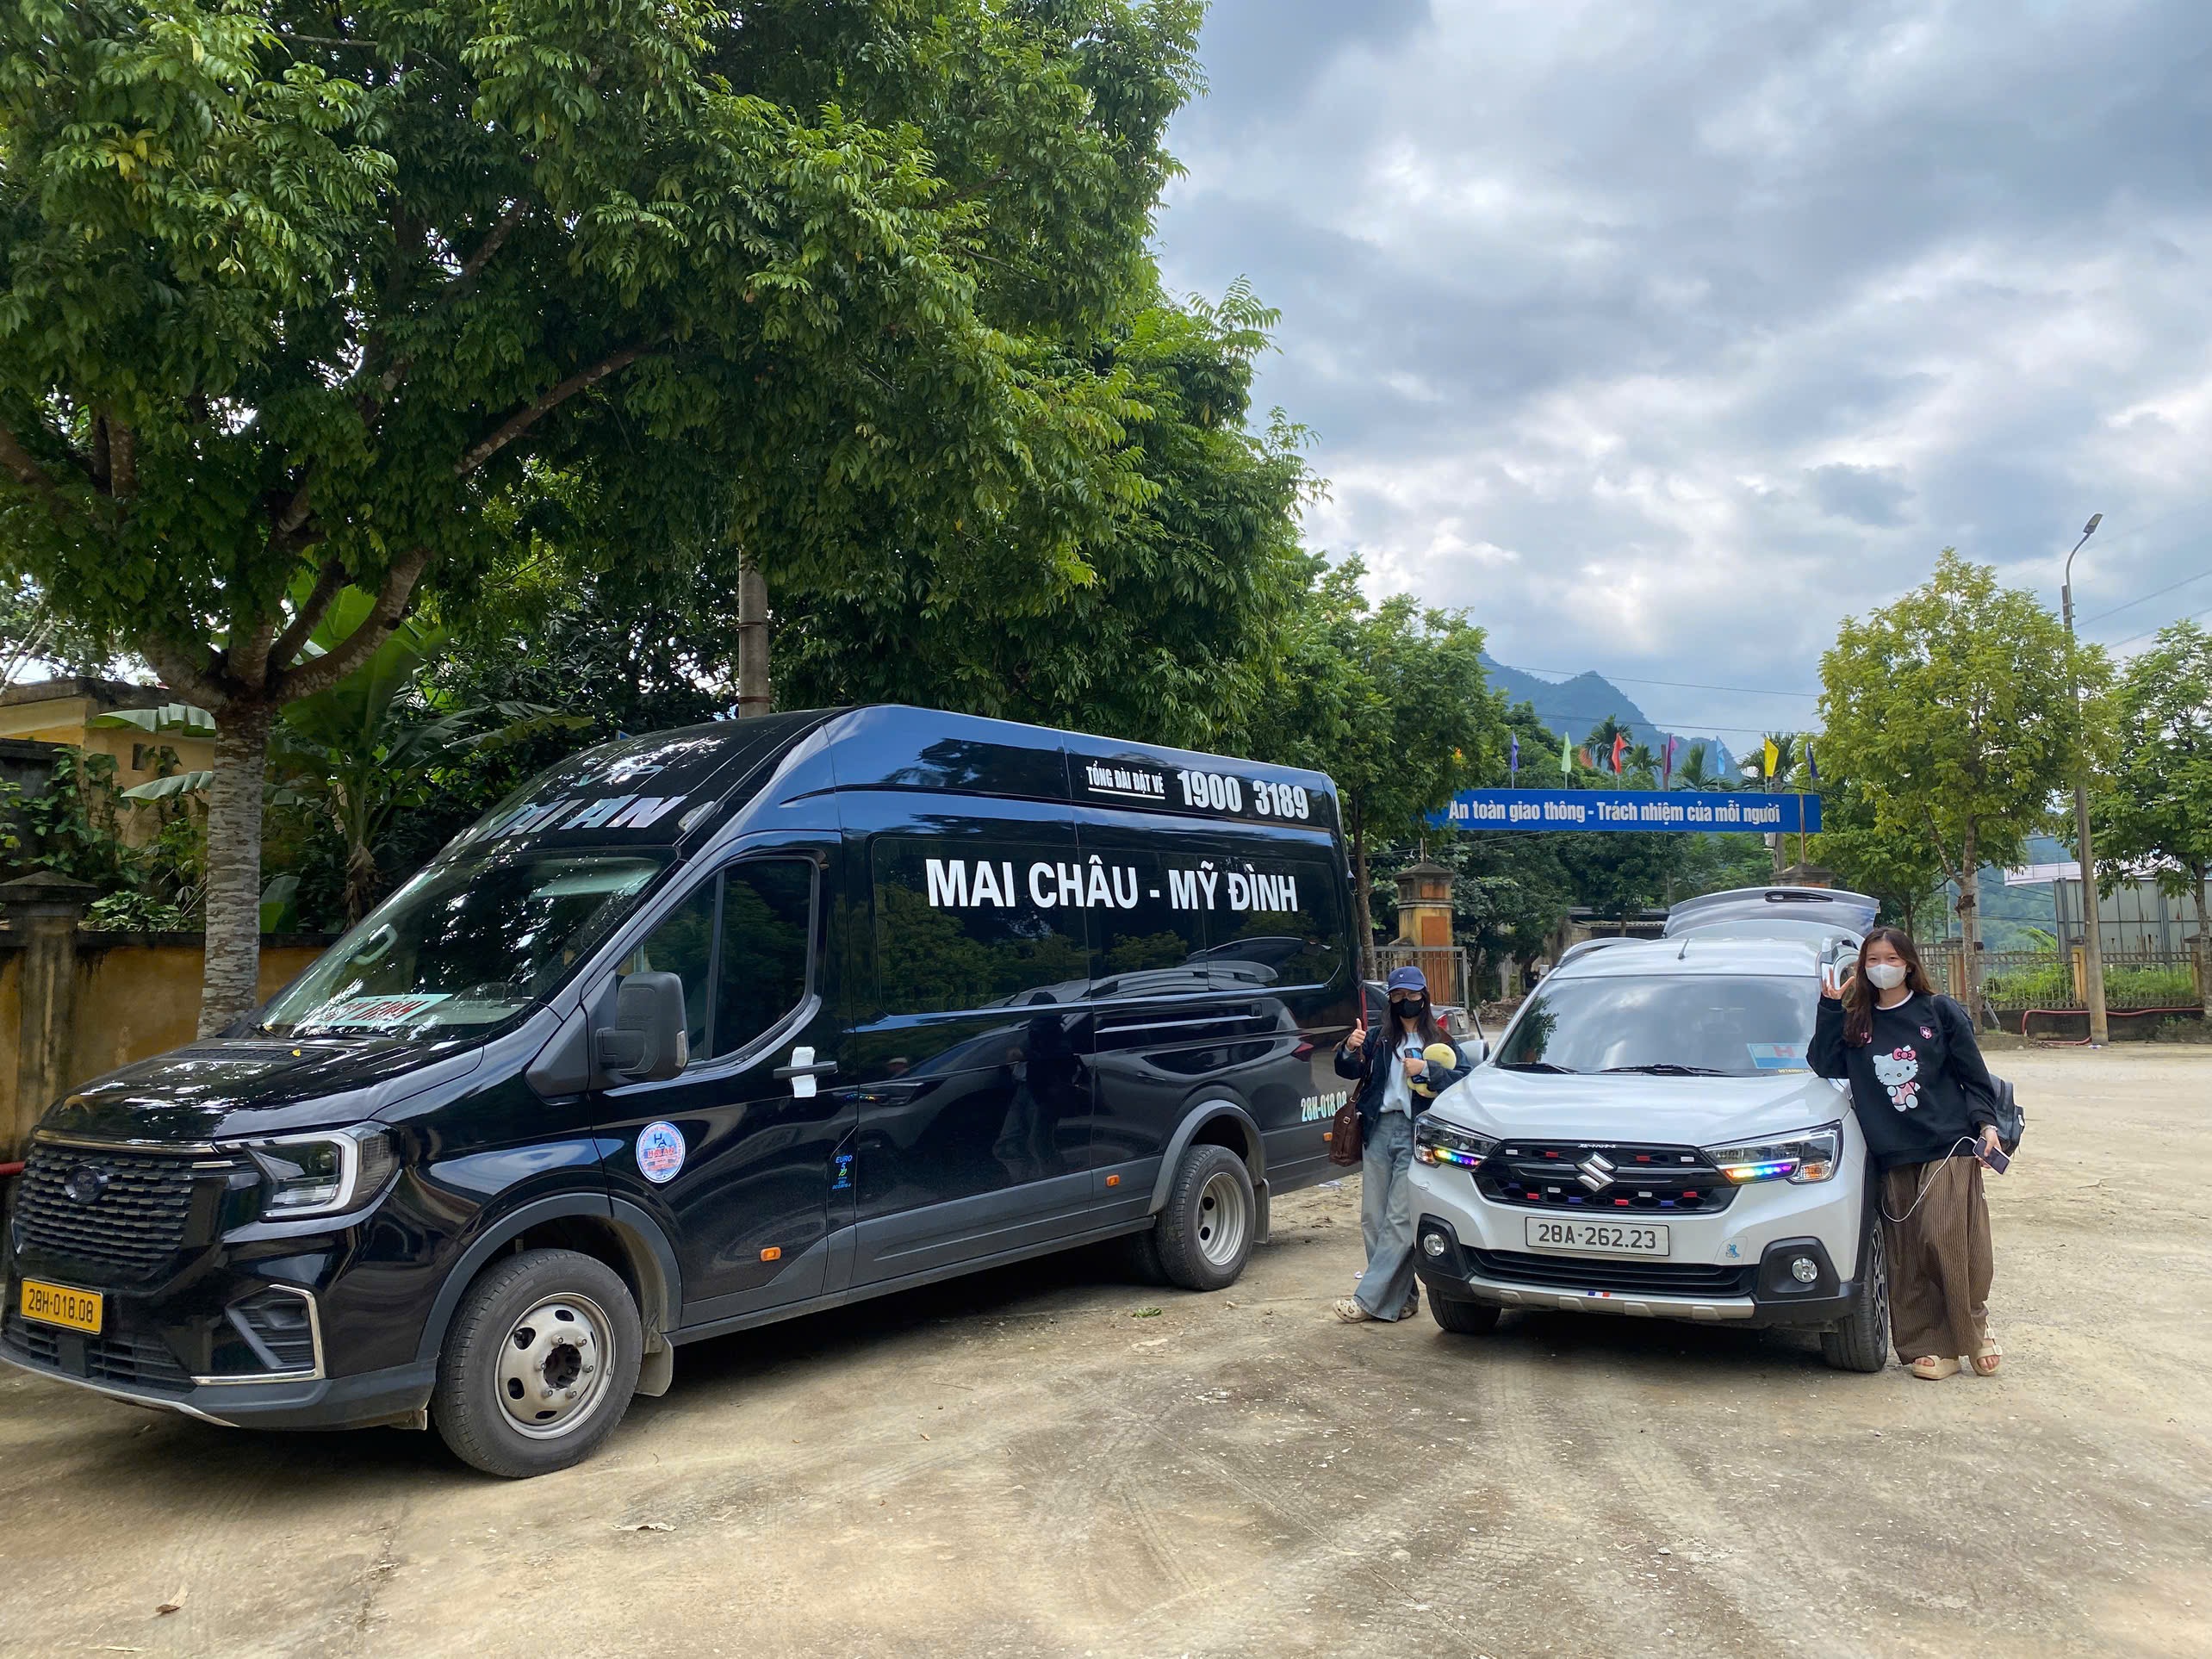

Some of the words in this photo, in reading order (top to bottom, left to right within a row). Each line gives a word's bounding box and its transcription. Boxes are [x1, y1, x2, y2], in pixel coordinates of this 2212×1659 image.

[1086, 761, 1114, 787] TỔNG
[1114, 767, 1132, 790] ĐÀI
[1132, 769, 1151, 794] ĐẶT
[1151, 772, 1165, 793] VÉ
[1177, 769, 1242, 812] 1900
[1252, 780, 1309, 819] 3189
[558, 793, 688, 830] AN
[1449, 800, 1469, 819] An
[1473, 800, 1506, 819] toàn
[1509, 801, 1540, 822] giao
[1544, 800, 1585, 823] thông
[1597, 800, 1638, 821] Trách
[1641, 802, 1683, 824] nhiệm
[1687, 800, 1712, 822] của
[1715, 800, 1740, 822] mỗi
[1743, 803, 1780, 824] người
[925, 858, 1016, 907] MAI
[1028, 854, 1139, 909] CHÂU
[1149, 889, 1160, 898] -
[1168, 860, 1218, 910] MỸ
[1227, 863, 1298, 911] ĐÌNH
[836, 1155, 853, 1164] EURO
[1538, 1224, 1656, 1249] 28A-262.23
[28, 1288, 94, 1323] 28H-018.08
